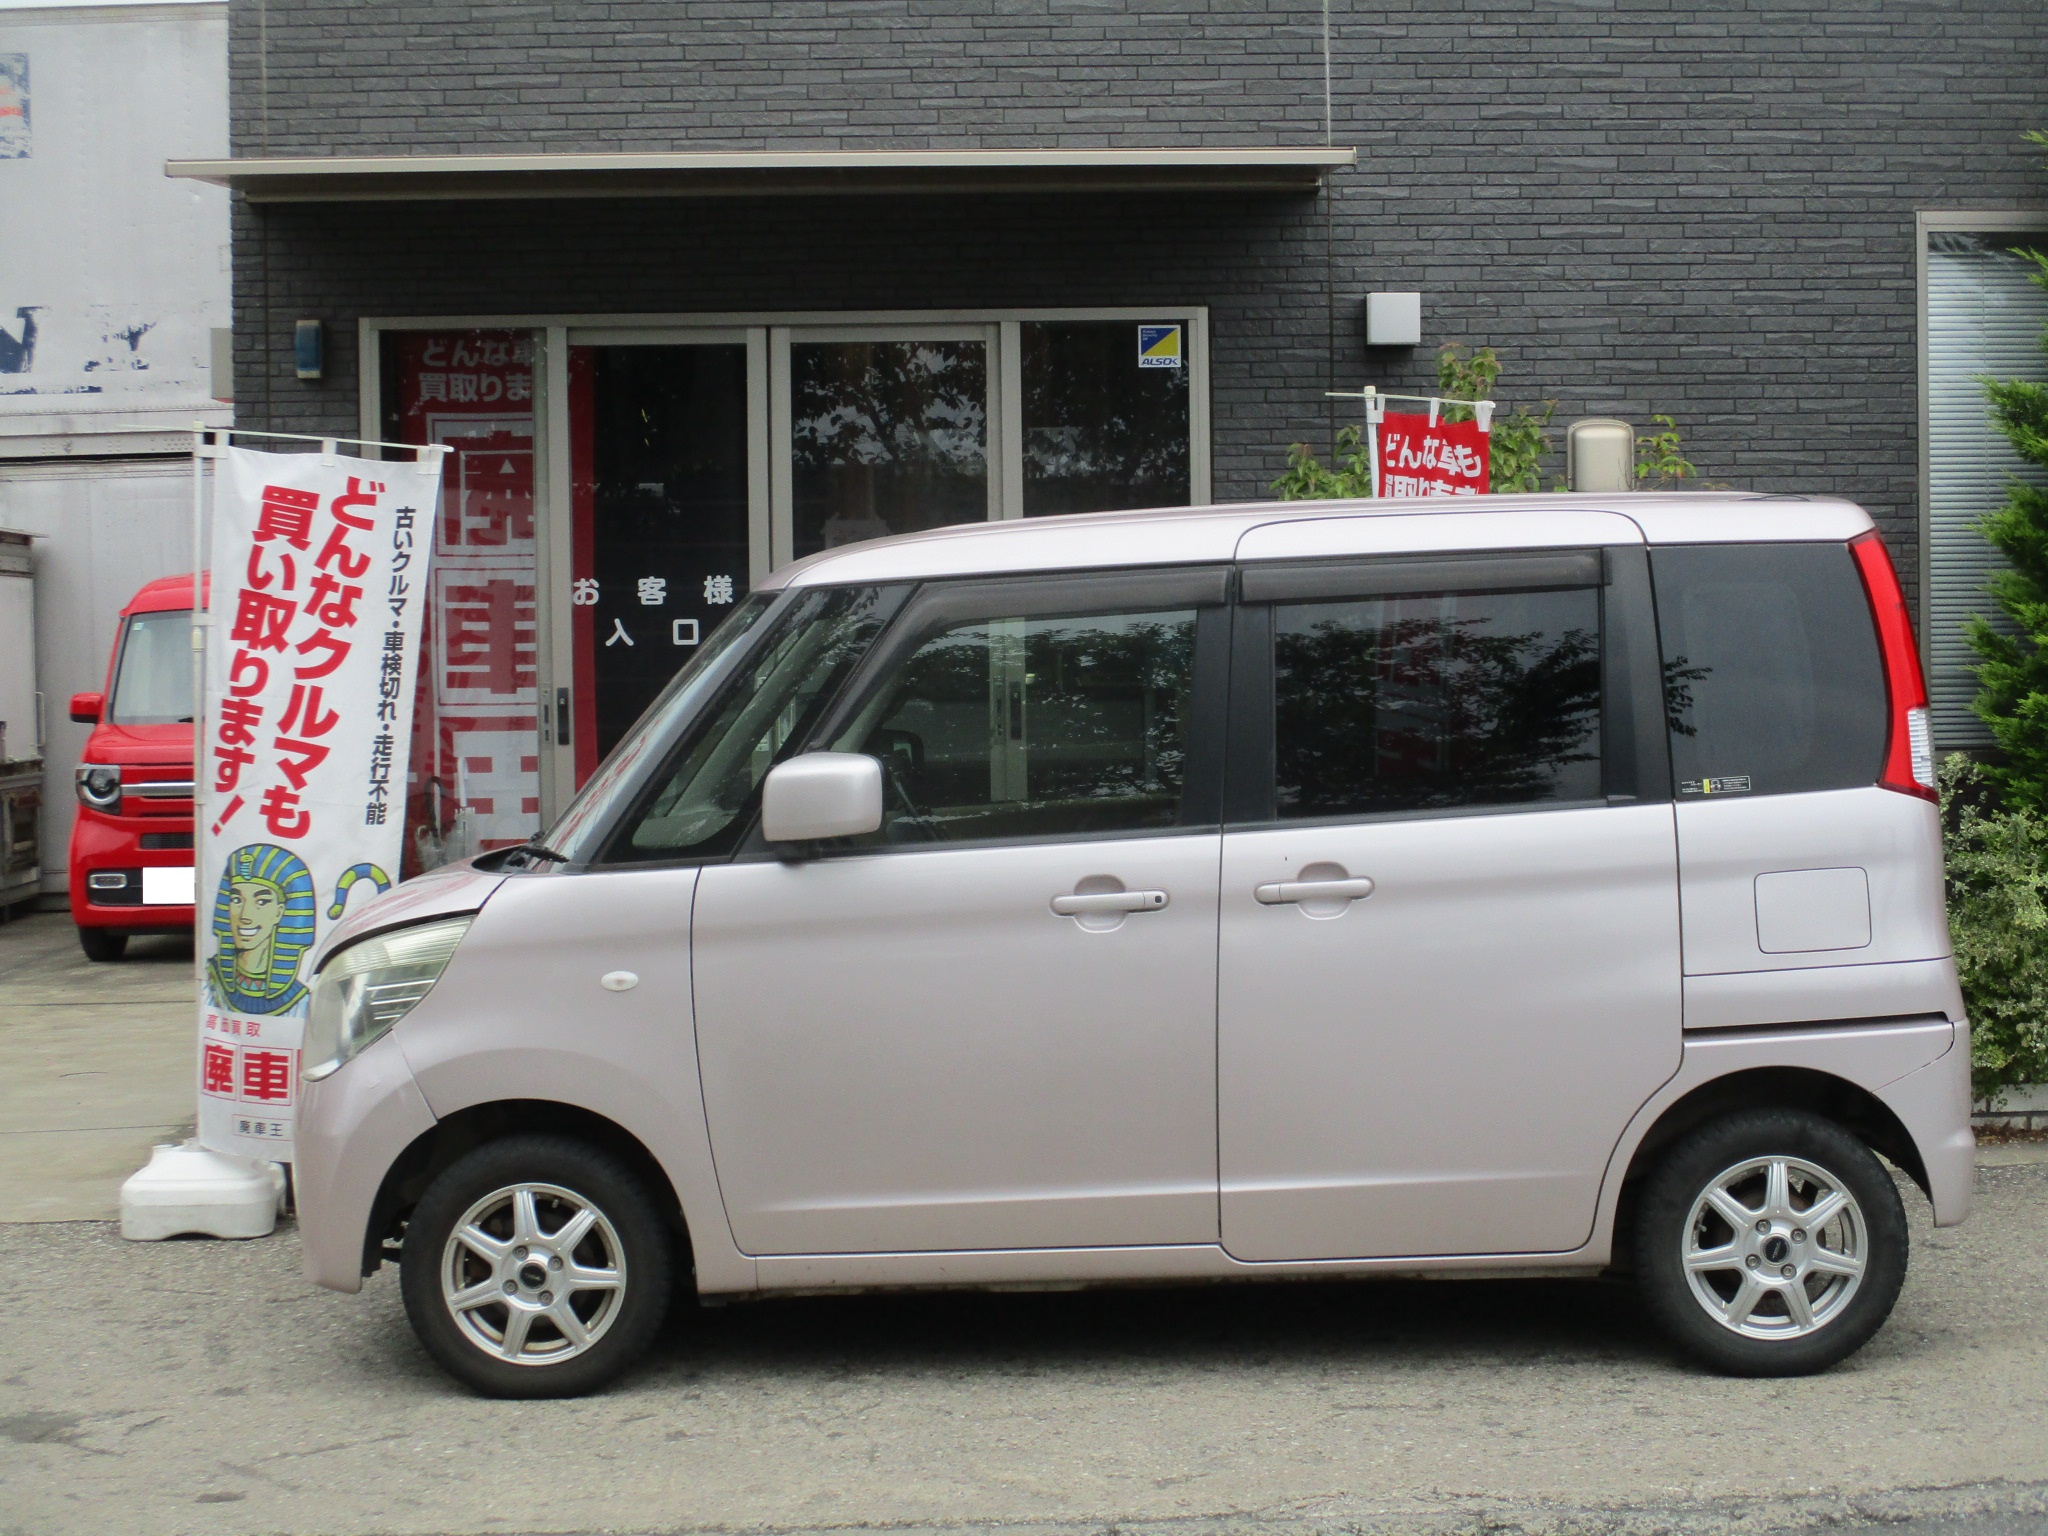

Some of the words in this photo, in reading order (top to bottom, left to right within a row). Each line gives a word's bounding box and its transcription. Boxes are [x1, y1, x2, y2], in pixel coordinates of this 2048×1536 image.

[422, 338, 532, 367] どんな車
[1141, 357, 1179, 366] ALSOK
[418, 372, 532, 402] 買取りま
[1386, 433, 1482, 478] どんな車も
[572, 575, 734, 606] お客様
[605, 618, 699, 647] 入口
[211, 484, 320, 837] 買い取ります!
[259, 475, 385, 840] どんなクルマも
[365, 506, 416, 826] 古いクルマ・車検切れ・走行不能
